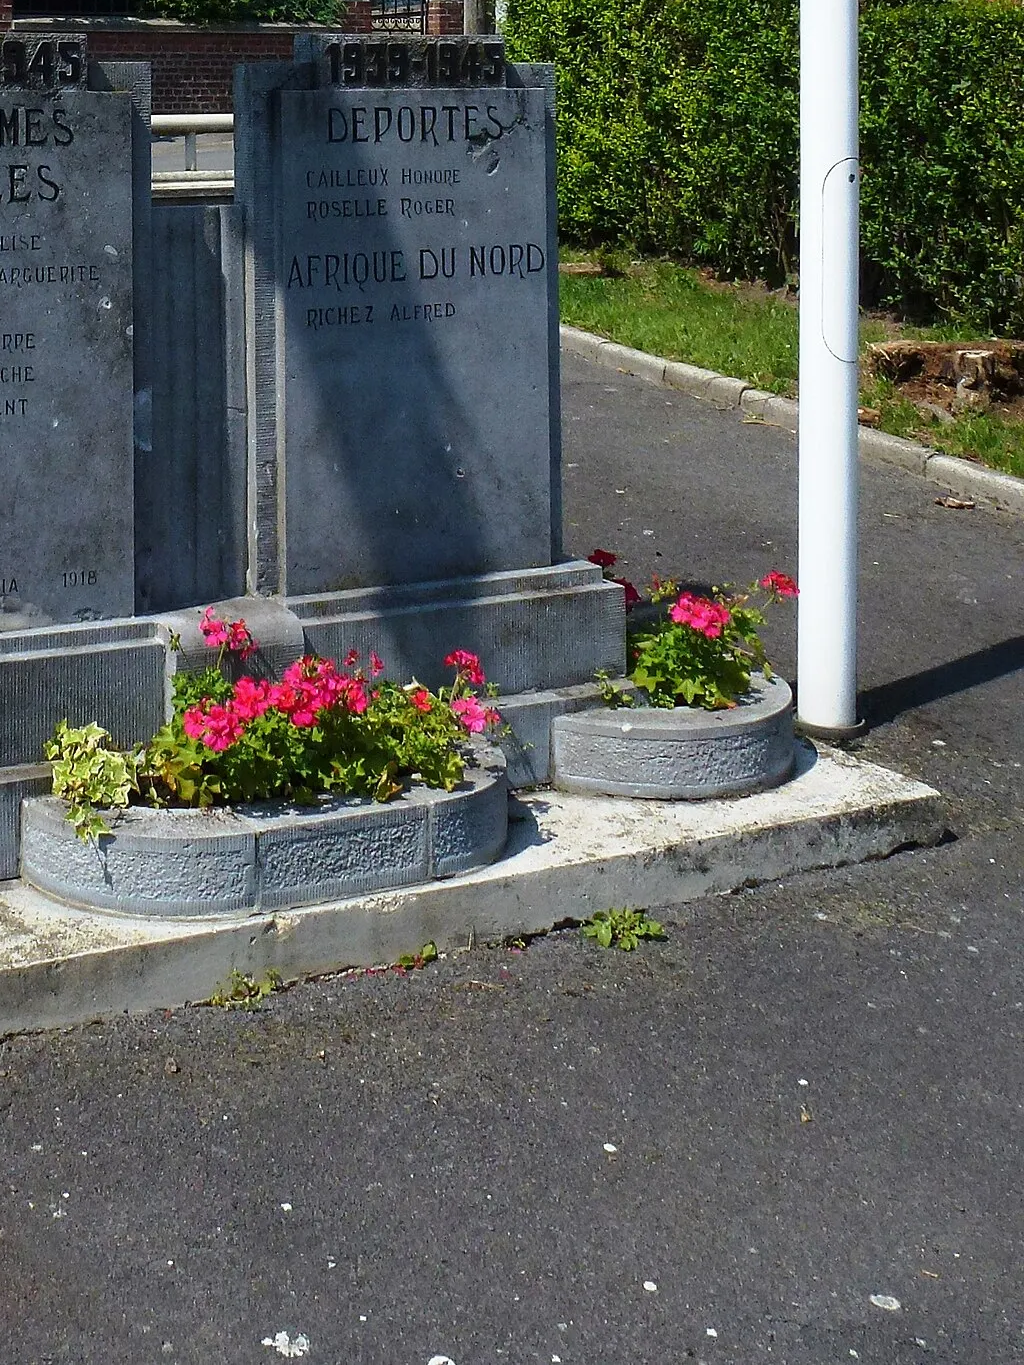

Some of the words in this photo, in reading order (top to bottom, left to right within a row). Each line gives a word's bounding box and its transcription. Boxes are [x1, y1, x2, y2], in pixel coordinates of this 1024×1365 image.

[325, 41, 505, 85] 1939-1945
[328, 105, 504, 146] DEPORTES
[306, 166, 389, 187] CAILLEUX
[401, 167, 461, 186] HONORE
[307, 198, 388, 221] ROSELLE
[400, 197, 456, 218] ROGER
[287, 250, 407, 292] AFRIQUE
[419, 247, 457, 280] DU
[470, 242, 545, 279] NORD
[307, 305, 374, 331] RICHEZ
[390, 302, 457, 322] ALFRED
[62, 569, 97, 588] 1918
